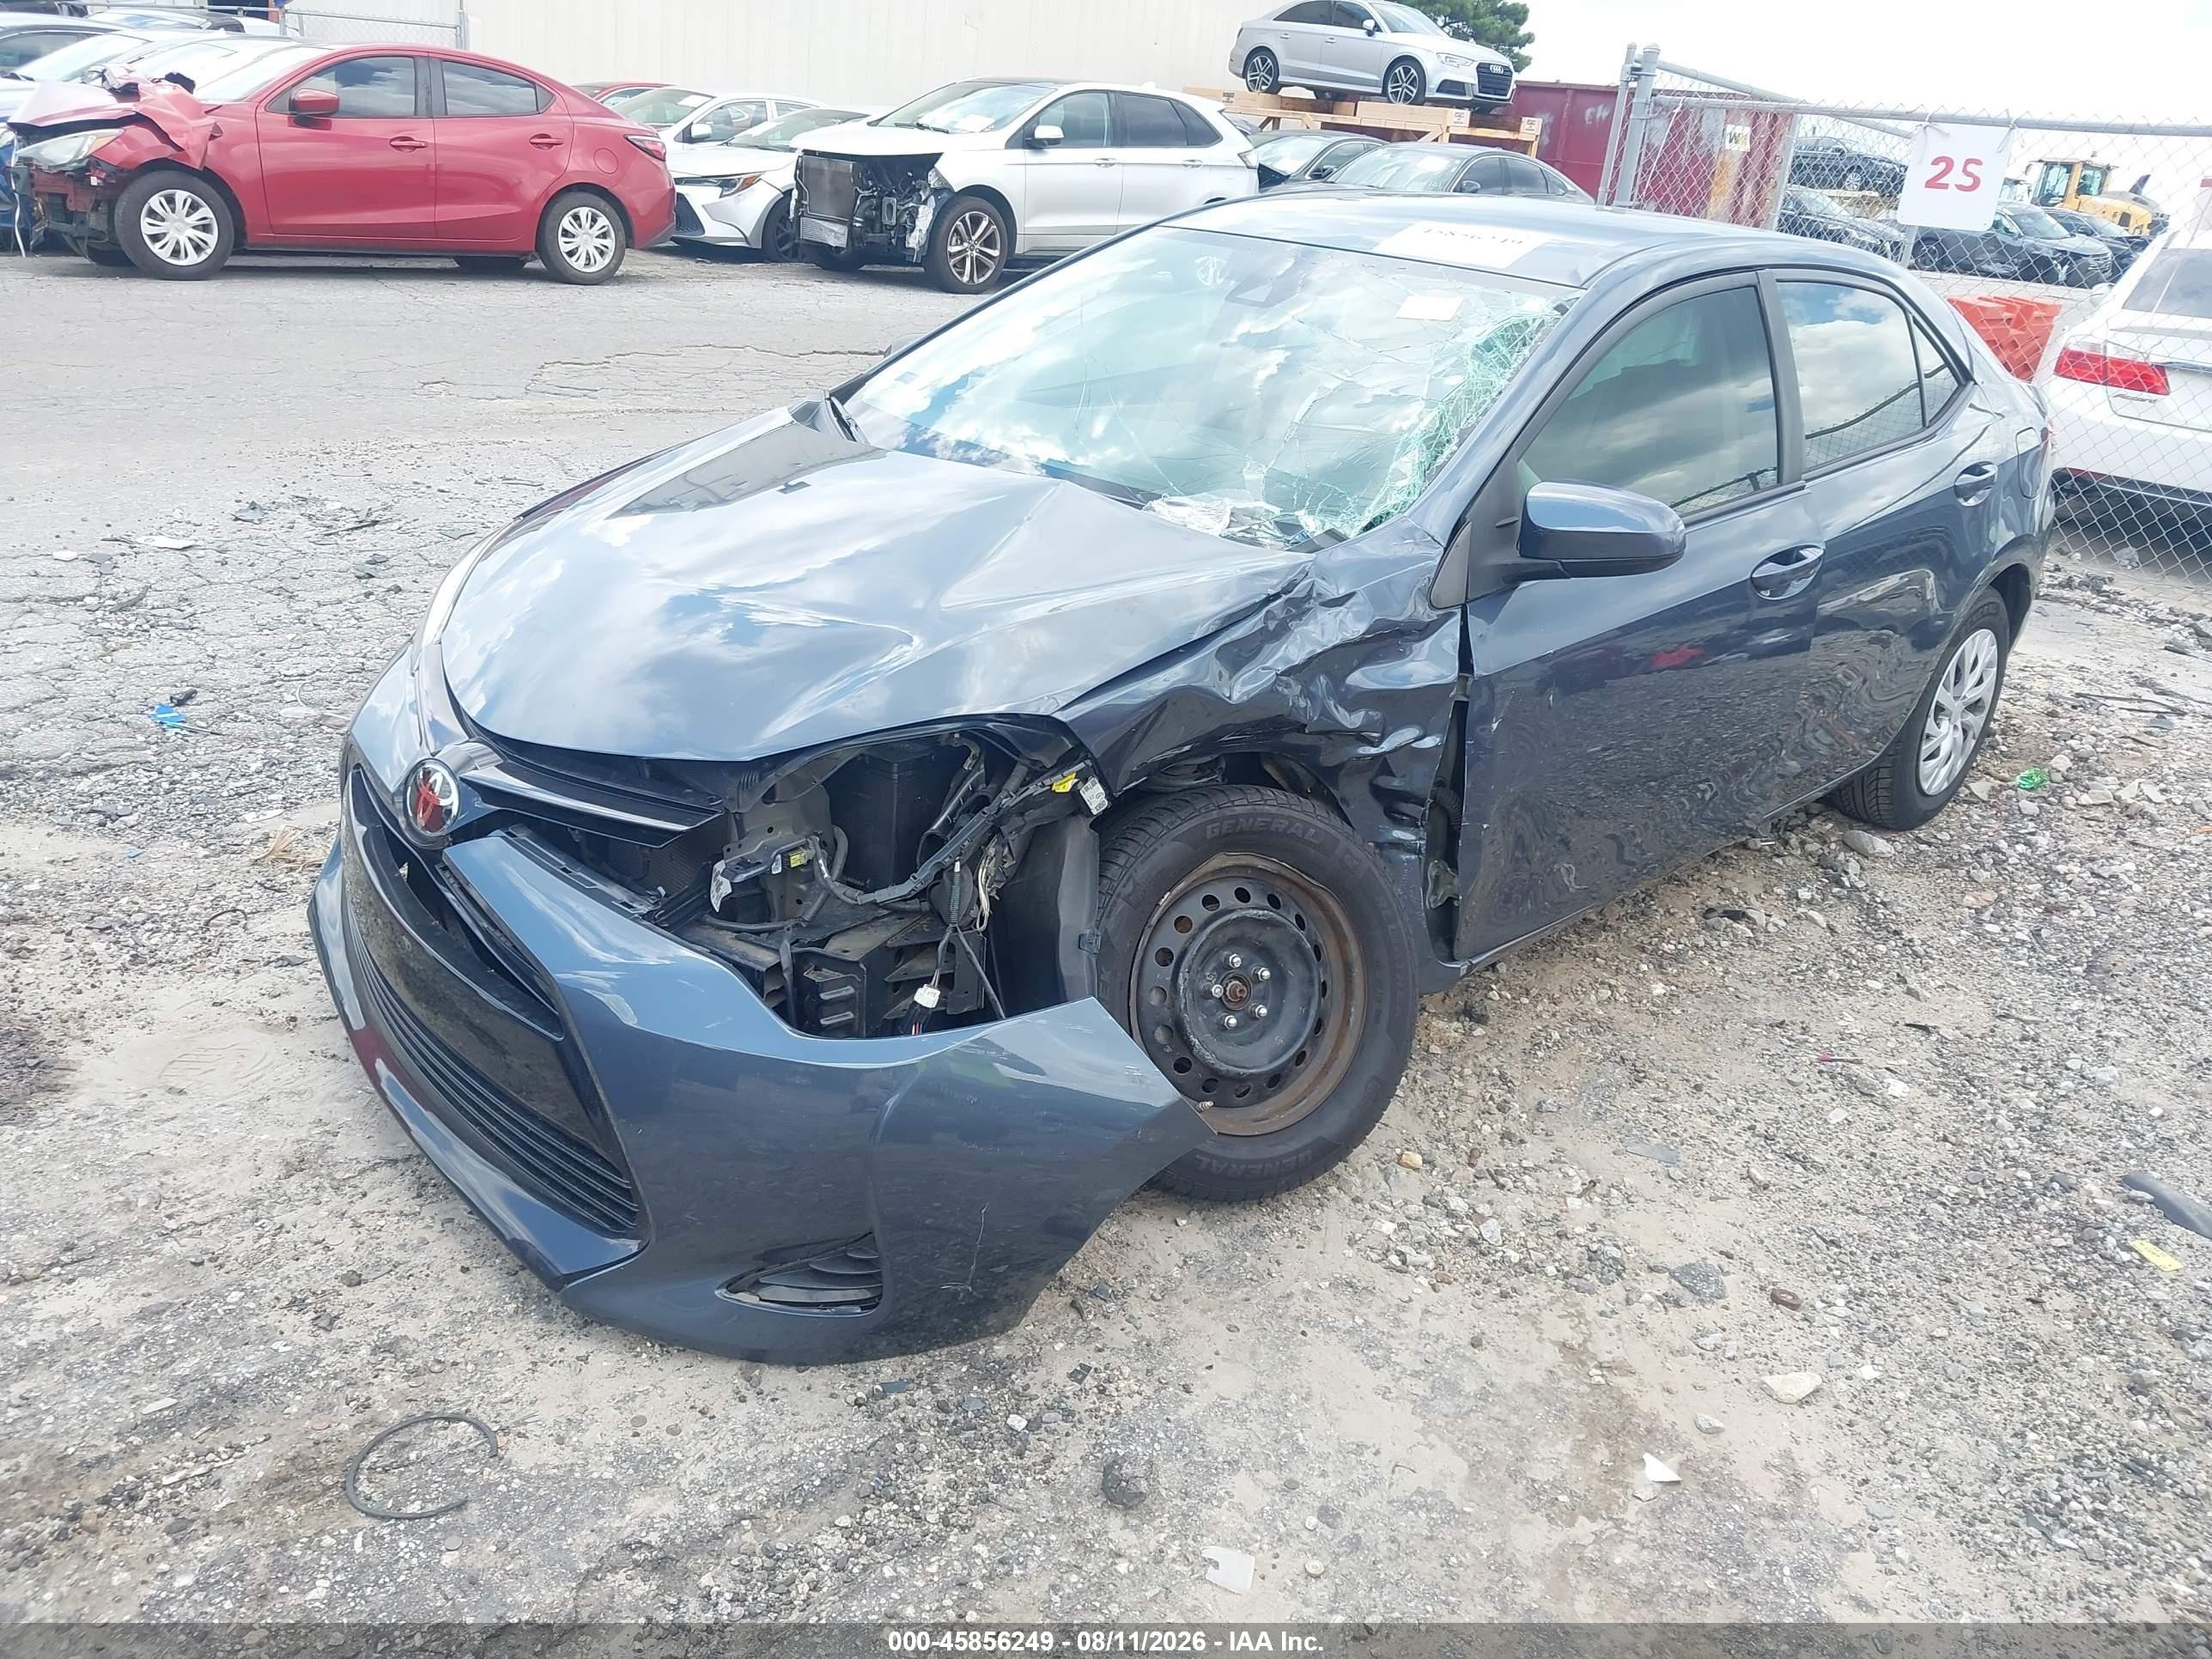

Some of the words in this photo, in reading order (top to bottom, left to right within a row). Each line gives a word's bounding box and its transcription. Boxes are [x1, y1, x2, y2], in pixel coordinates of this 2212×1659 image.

[1924, 155, 1983, 191] 2S
[2112, 393, 2158, 404] Accord
[1205, 816, 1325, 845] GENERAL
[1194, 1150, 1313, 1178] GENERAL
